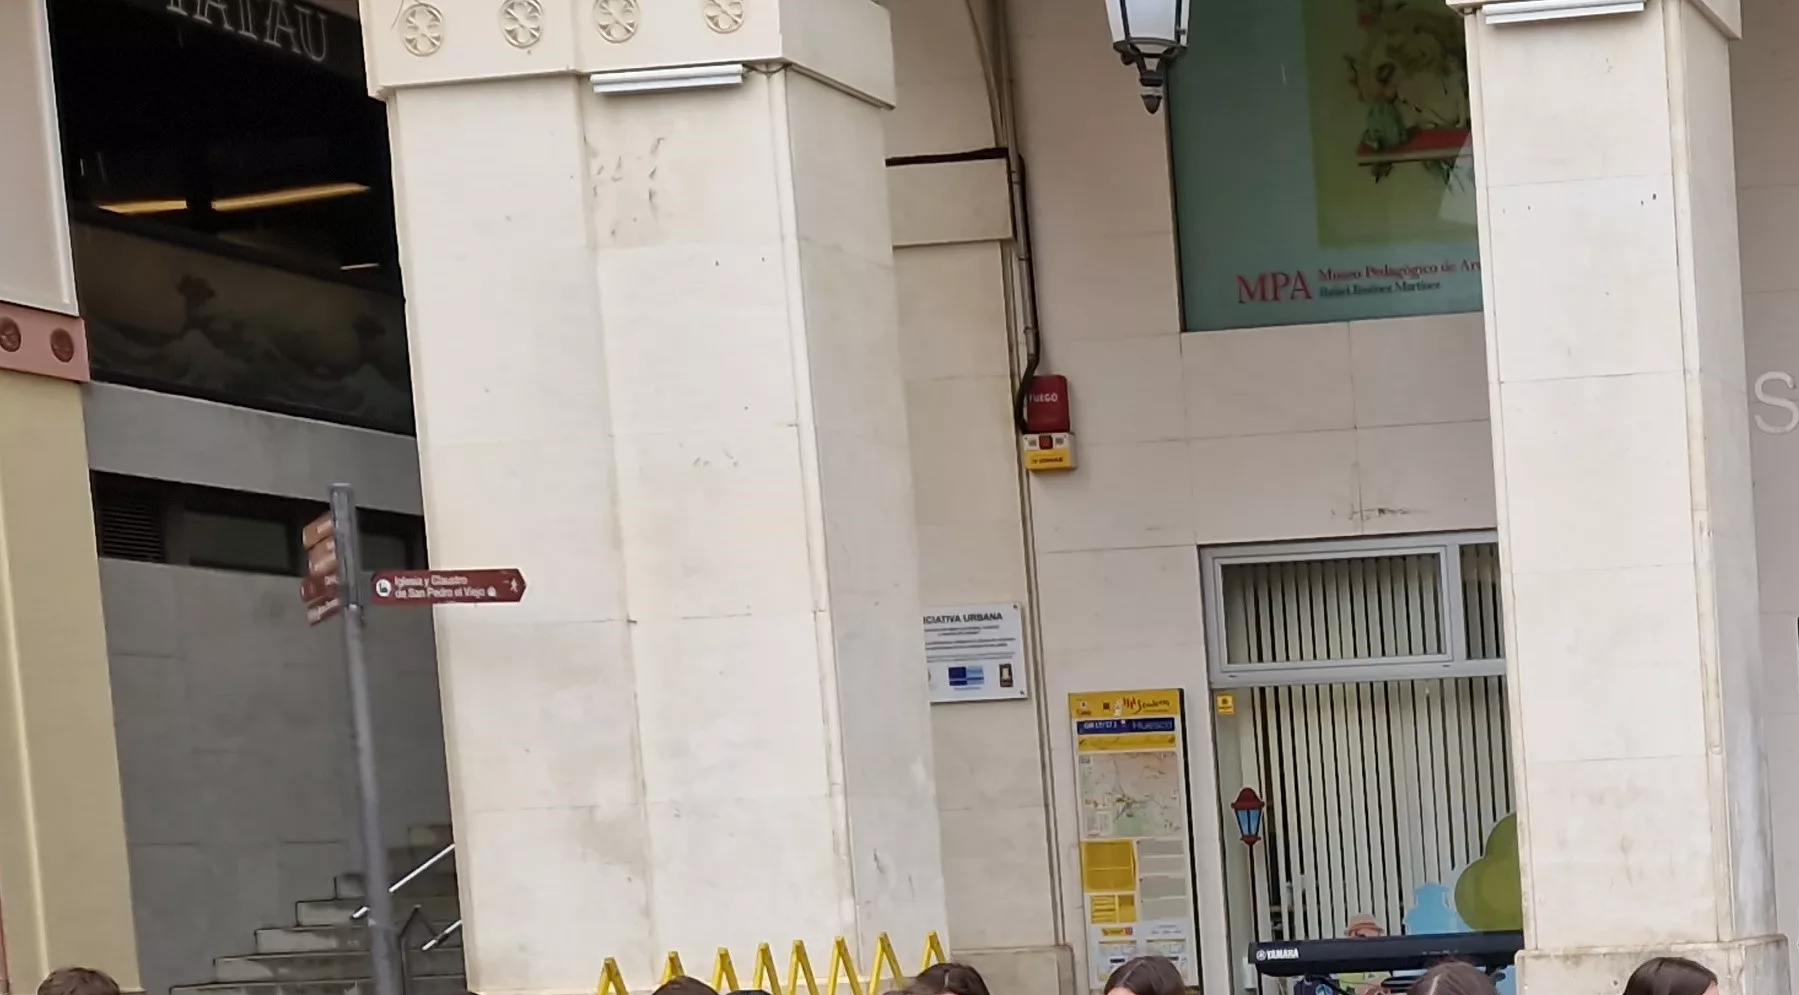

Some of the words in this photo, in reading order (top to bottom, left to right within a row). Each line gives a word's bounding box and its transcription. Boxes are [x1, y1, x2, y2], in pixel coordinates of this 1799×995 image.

[1236, 270, 1313, 304] MPA
[963, 613, 1003, 622] URBANA
[1267, 948, 1299, 959] YAMAHA
